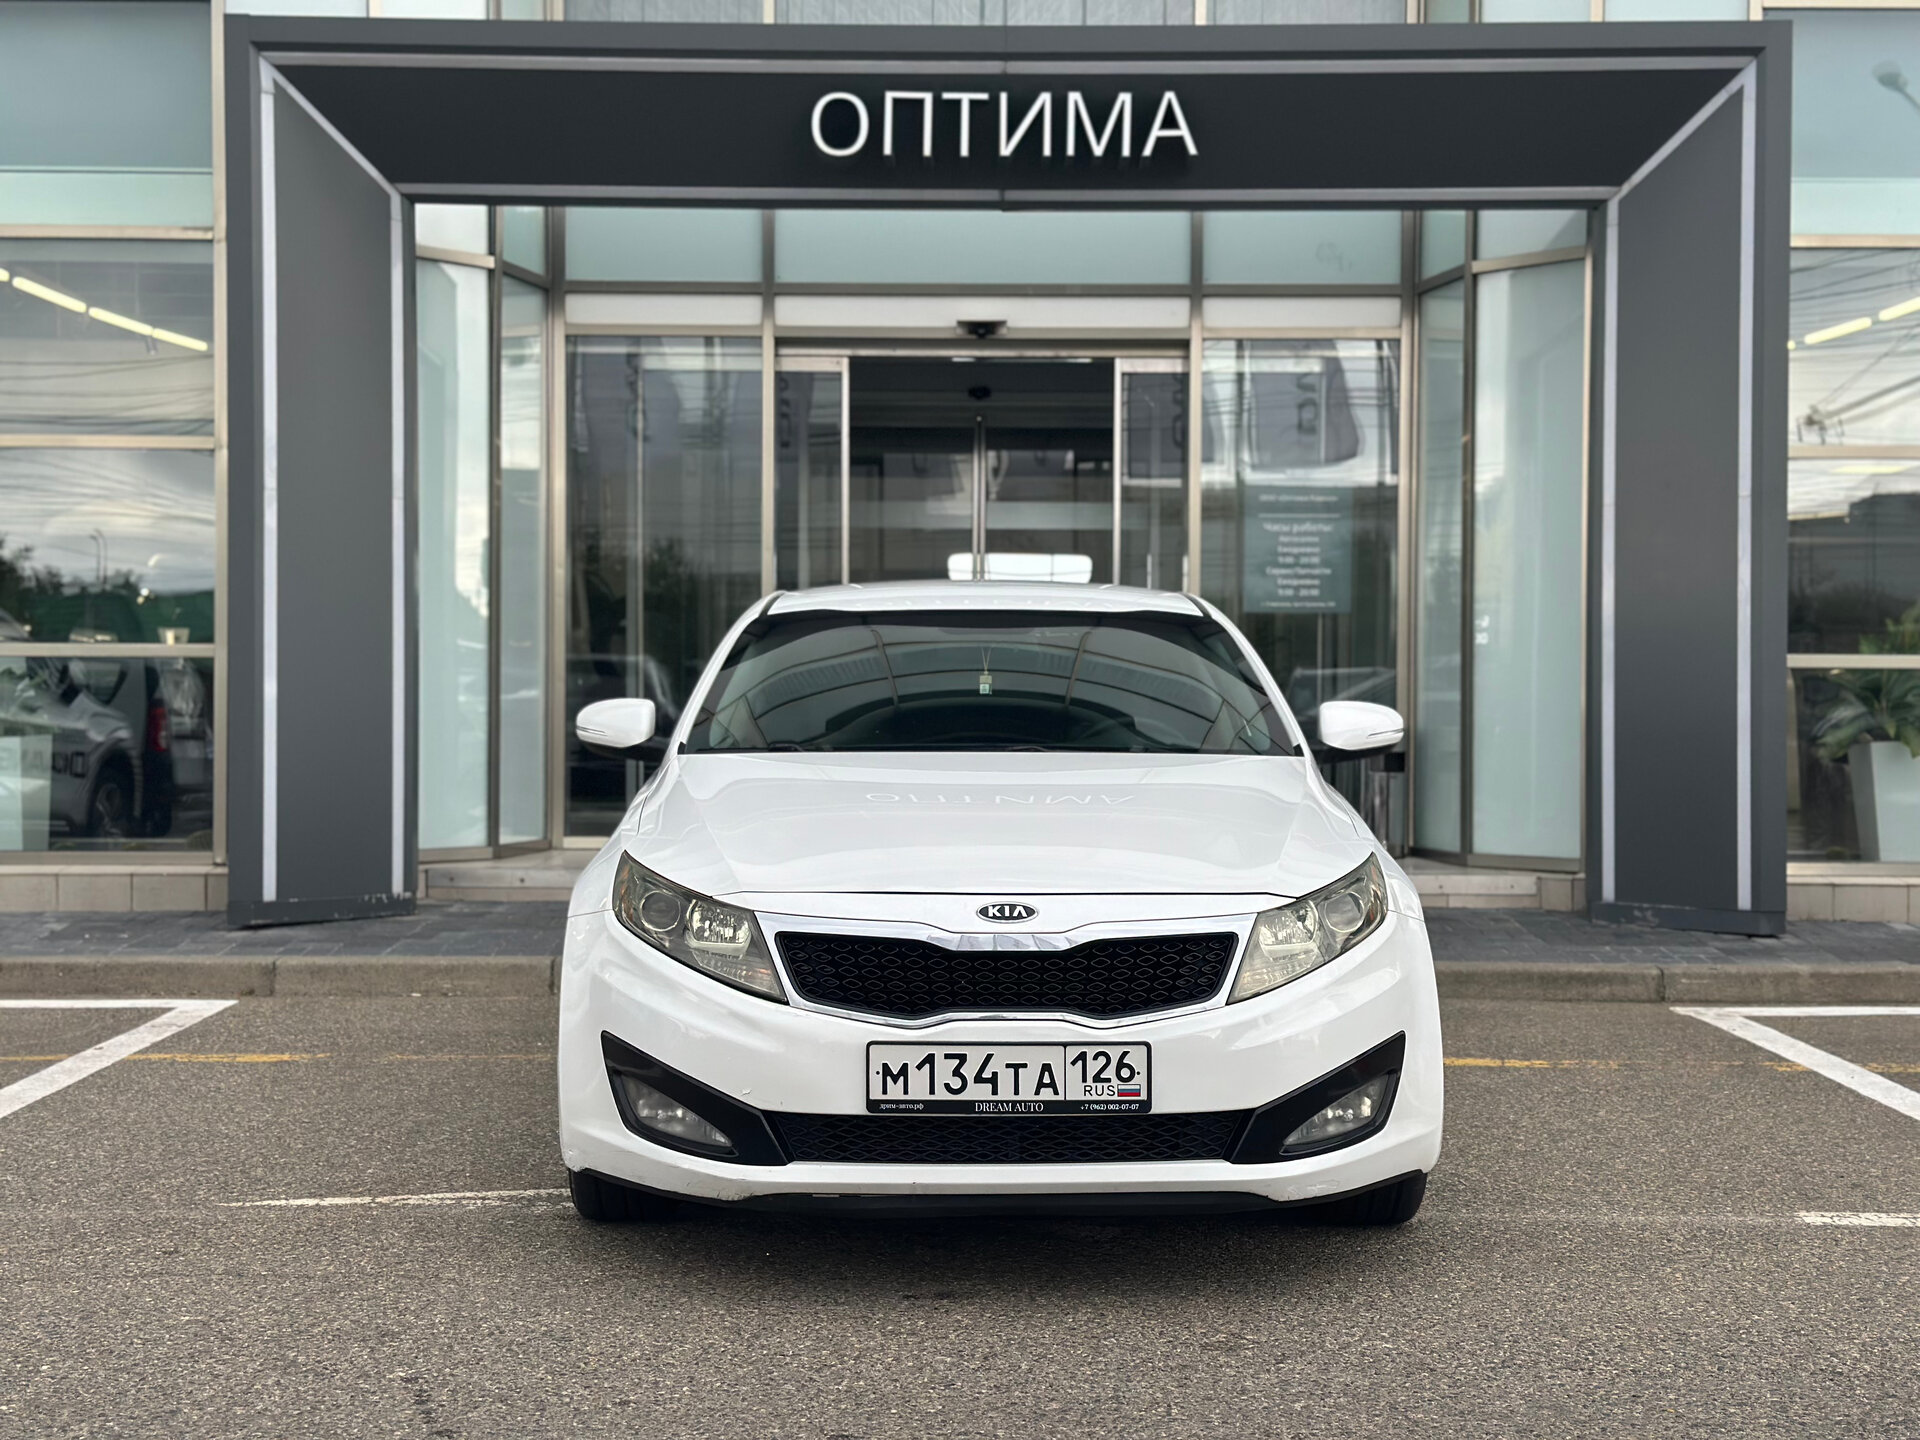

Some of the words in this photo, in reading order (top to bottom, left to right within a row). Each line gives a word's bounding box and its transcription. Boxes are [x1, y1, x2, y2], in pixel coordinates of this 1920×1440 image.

[811, 91, 1199, 158] ОПТИМА
[988, 905, 1028, 918] KIA
[881, 1052, 1060, 1096] М134ТА
[1070, 1050, 1137, 1084] 126
[1083, 1084, 1116, 1097] RUS
[975, 1102, 1012, 1113] DREAM
[1013, 1102, 1044, 1113] AUTO
[1089, 1103, 1107, 1111] (962)
